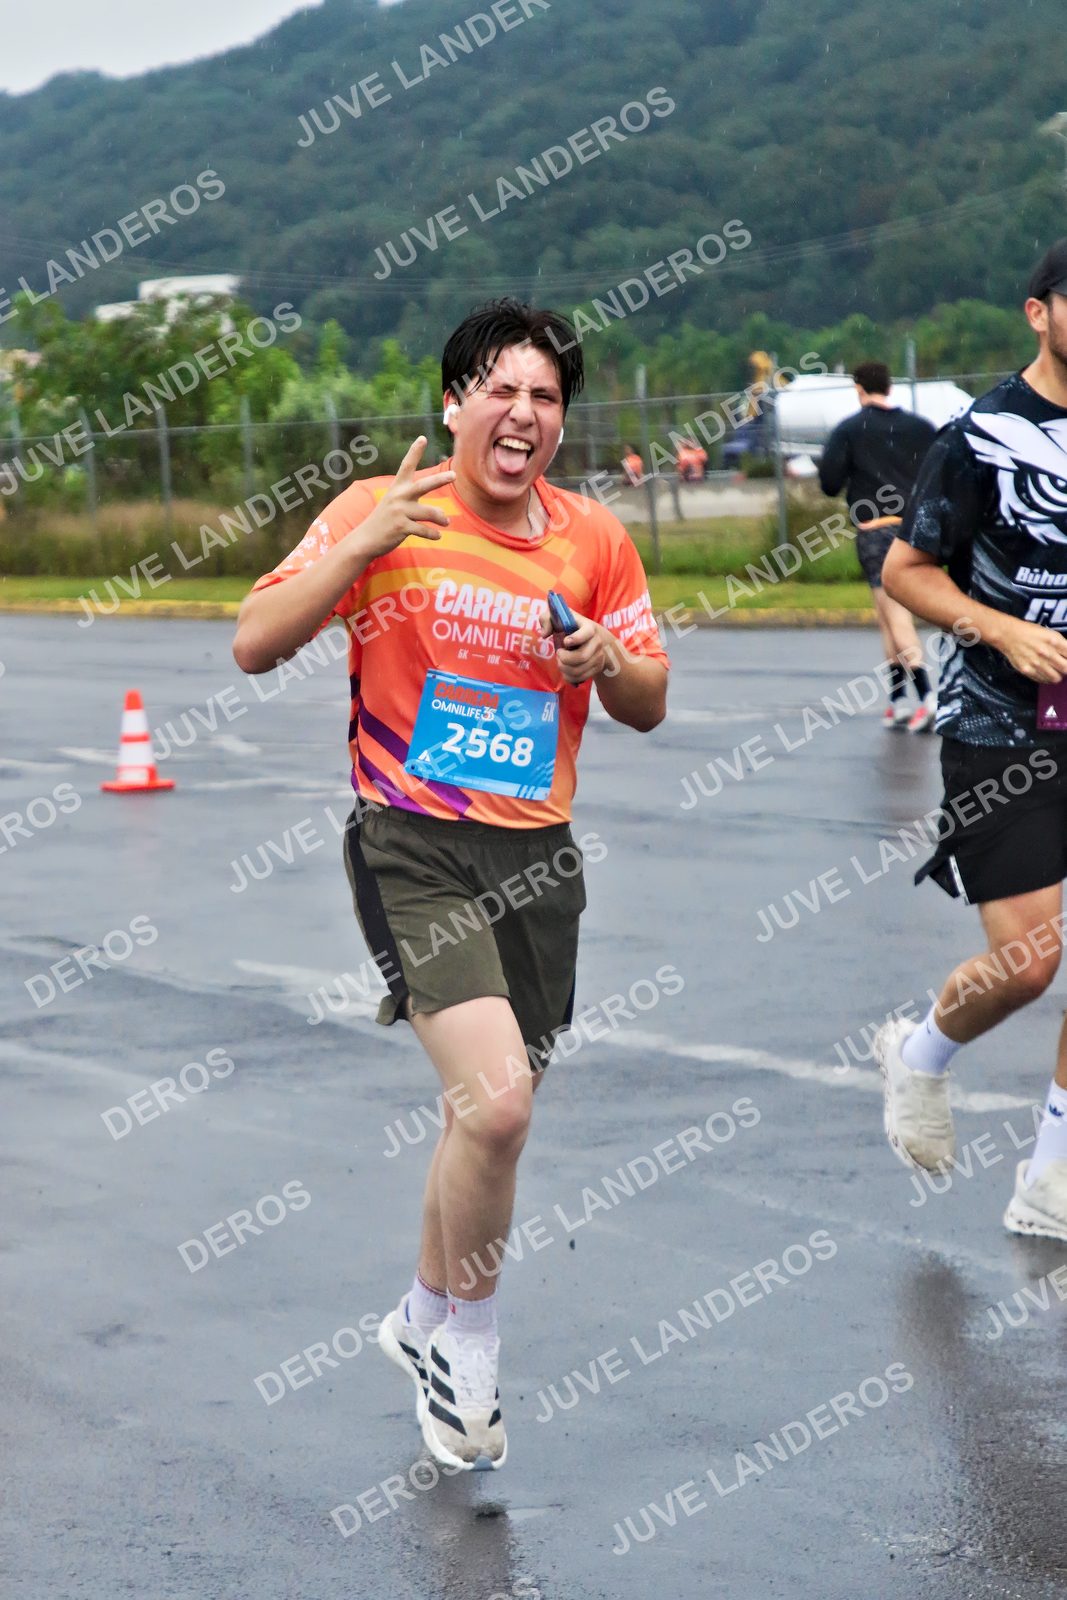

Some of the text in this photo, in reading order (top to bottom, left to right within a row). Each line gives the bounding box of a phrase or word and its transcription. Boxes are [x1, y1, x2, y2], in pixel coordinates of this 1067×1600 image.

[434, 579, 550, 633] CARRER
[432, 618, 533, 655] OMNILIFE
[431, 698, 482, 720] OMNILIFE
[434, 681, 500, 709] CARRERA
[541, 701, 557, 723] 5K
[441, 722, 534, 768] 2568
